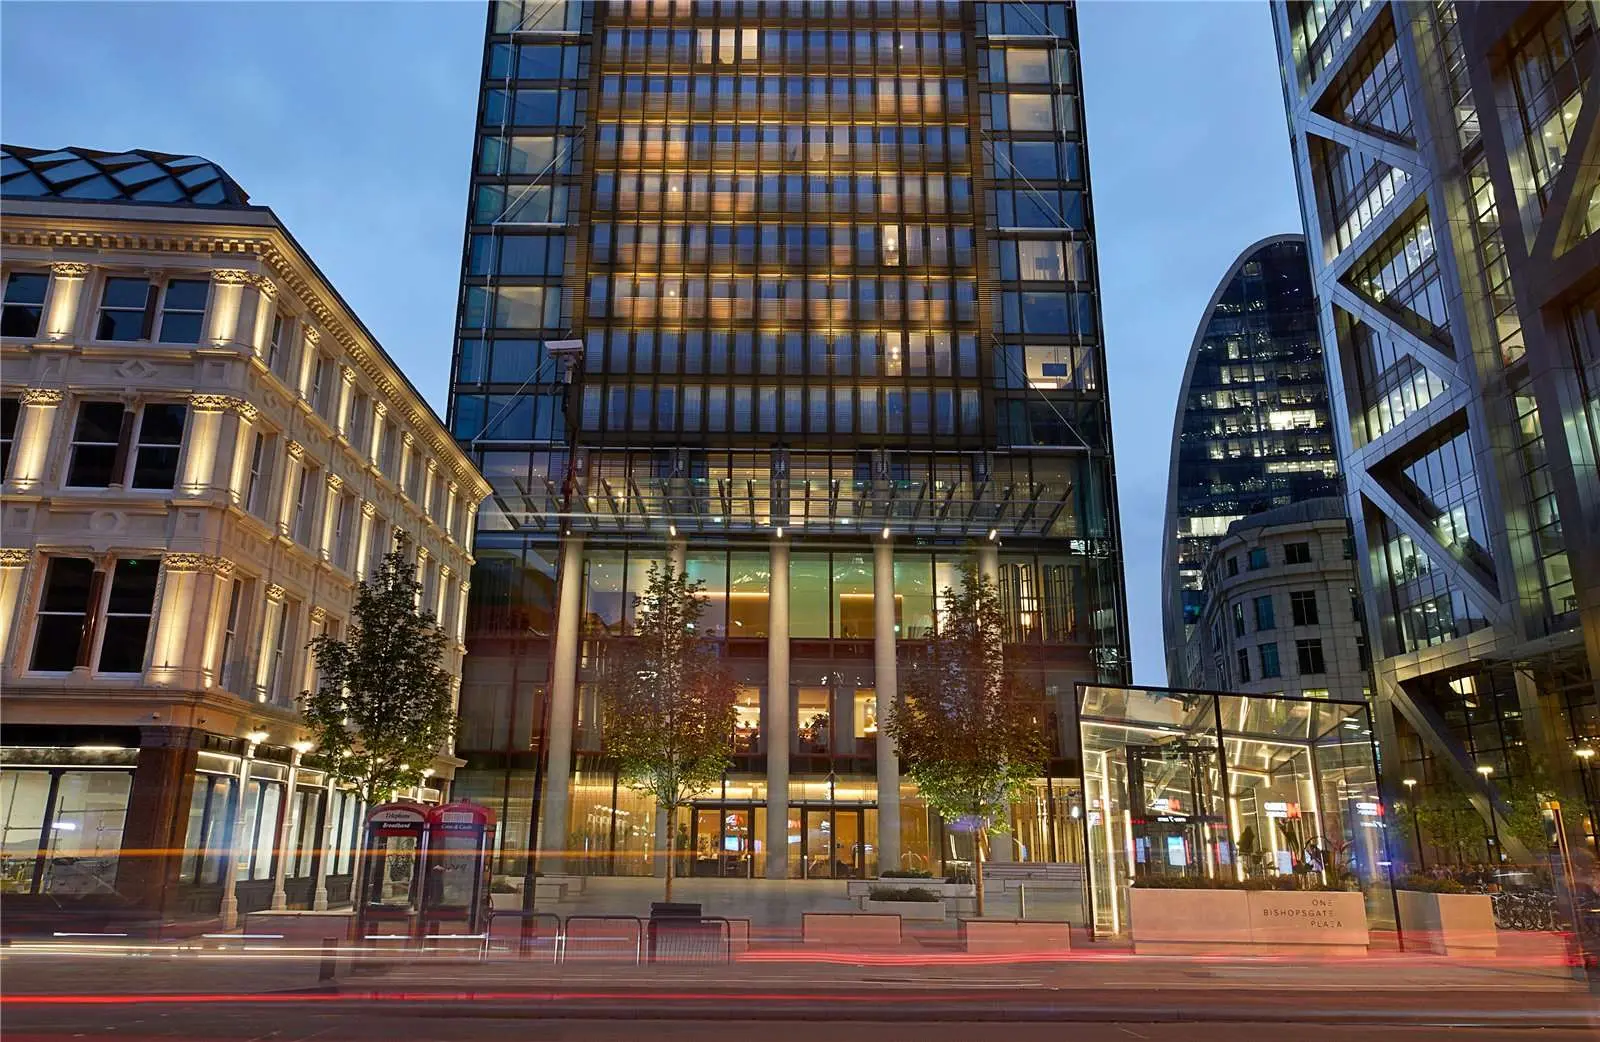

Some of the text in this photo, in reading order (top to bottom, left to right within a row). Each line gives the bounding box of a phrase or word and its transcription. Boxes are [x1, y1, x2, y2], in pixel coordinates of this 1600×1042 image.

[1312, 899, 1333, 907] ONE
[1263, 908, 1334, 917] BISHOPSGATE
[1310, 920, 1342, 928] PLAZA
